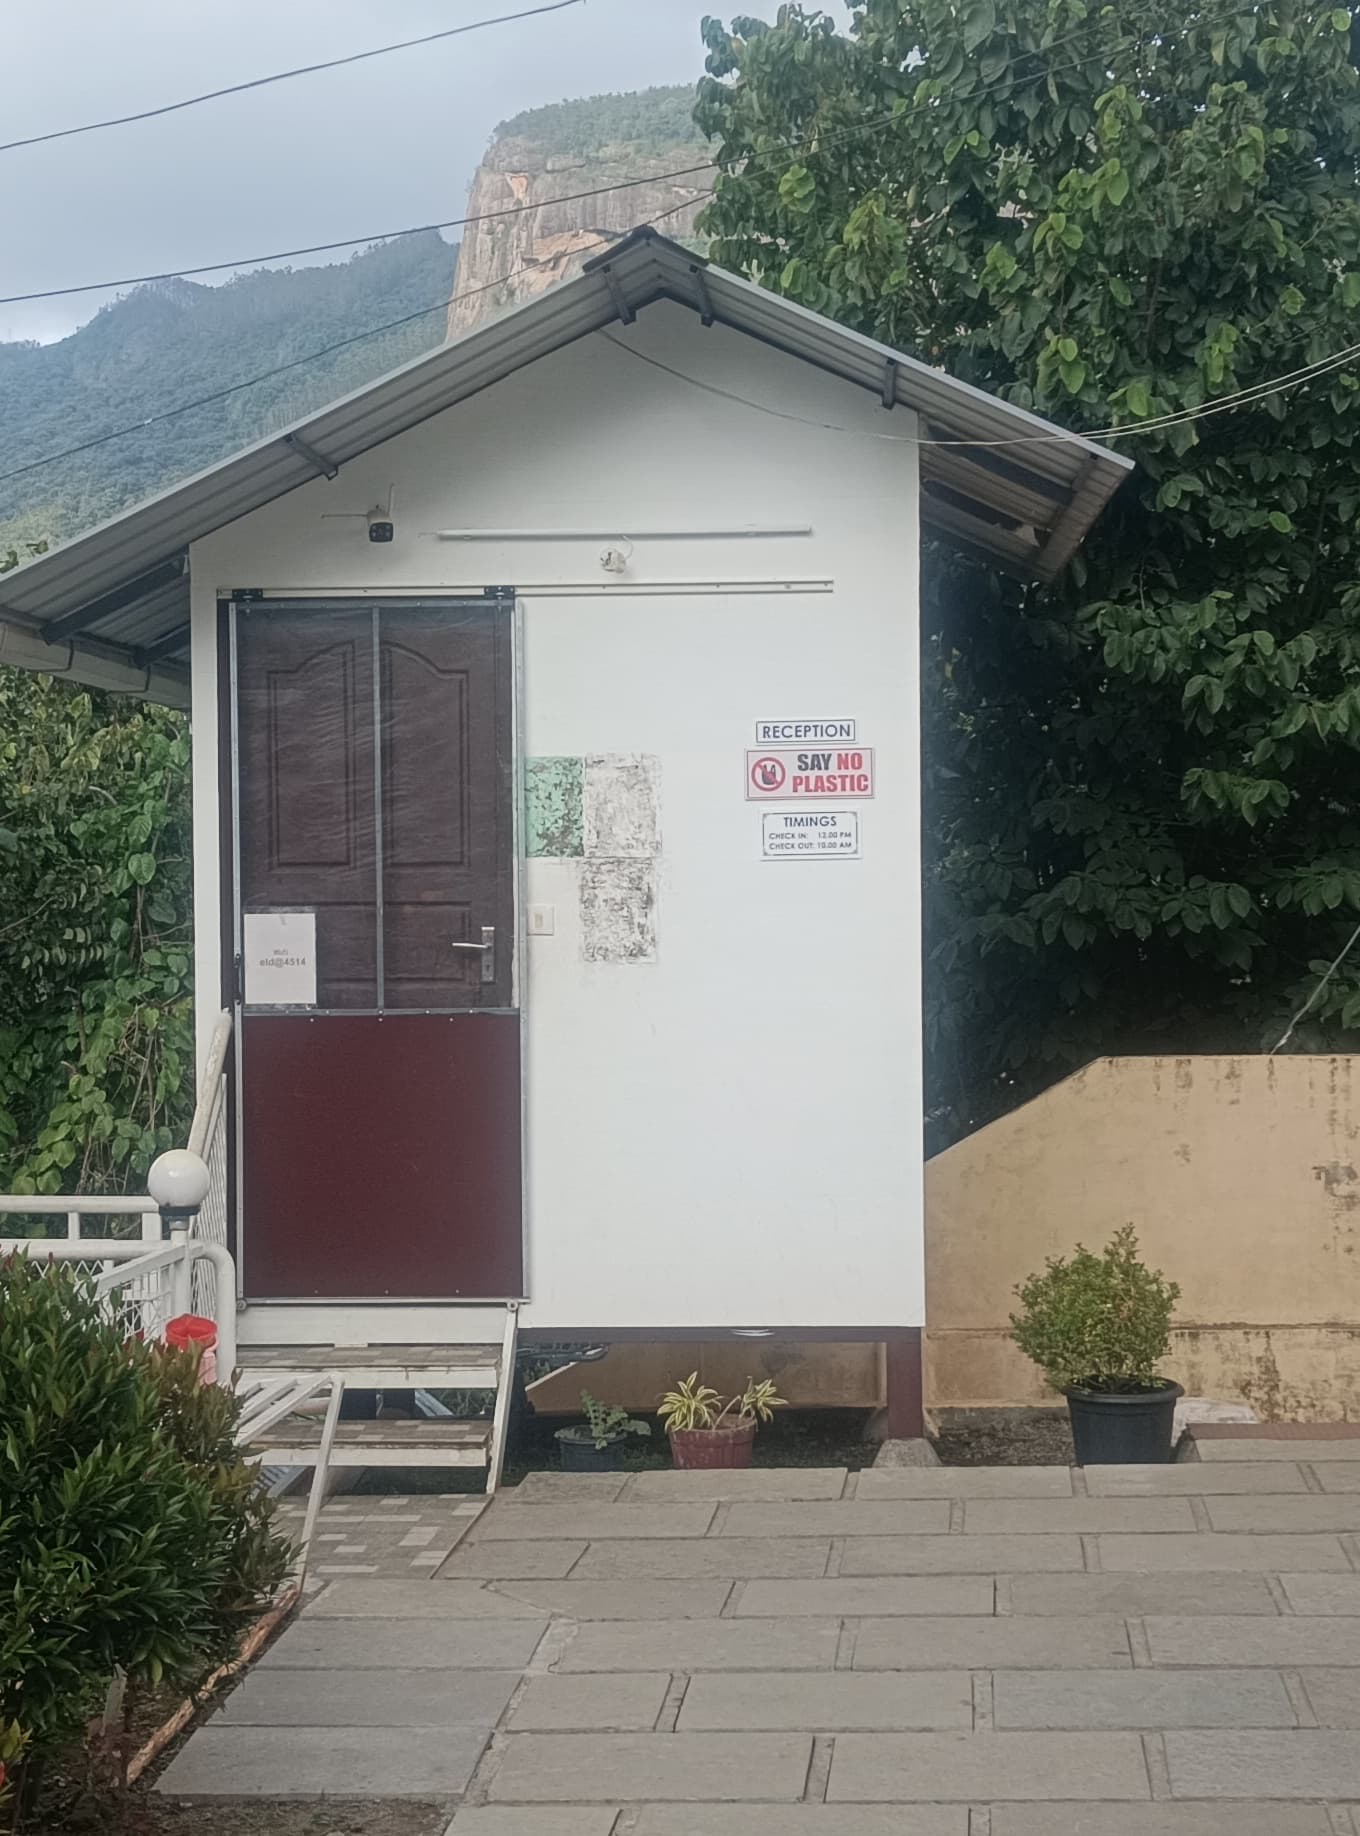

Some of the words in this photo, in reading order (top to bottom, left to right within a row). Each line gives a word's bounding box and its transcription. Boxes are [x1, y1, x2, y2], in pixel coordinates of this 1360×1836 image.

[762, 724, 850, 739] RECEPTION
[797, 753, 832, 771] SAY
[837, 752, 863, 770] NO
[792, 774, 869, 793] PLASTIC
[783, 816, 837, 827] TIMINGS
[768, 832, 795, 840] CHECK
[768, 842, 795, 850] CHECK
